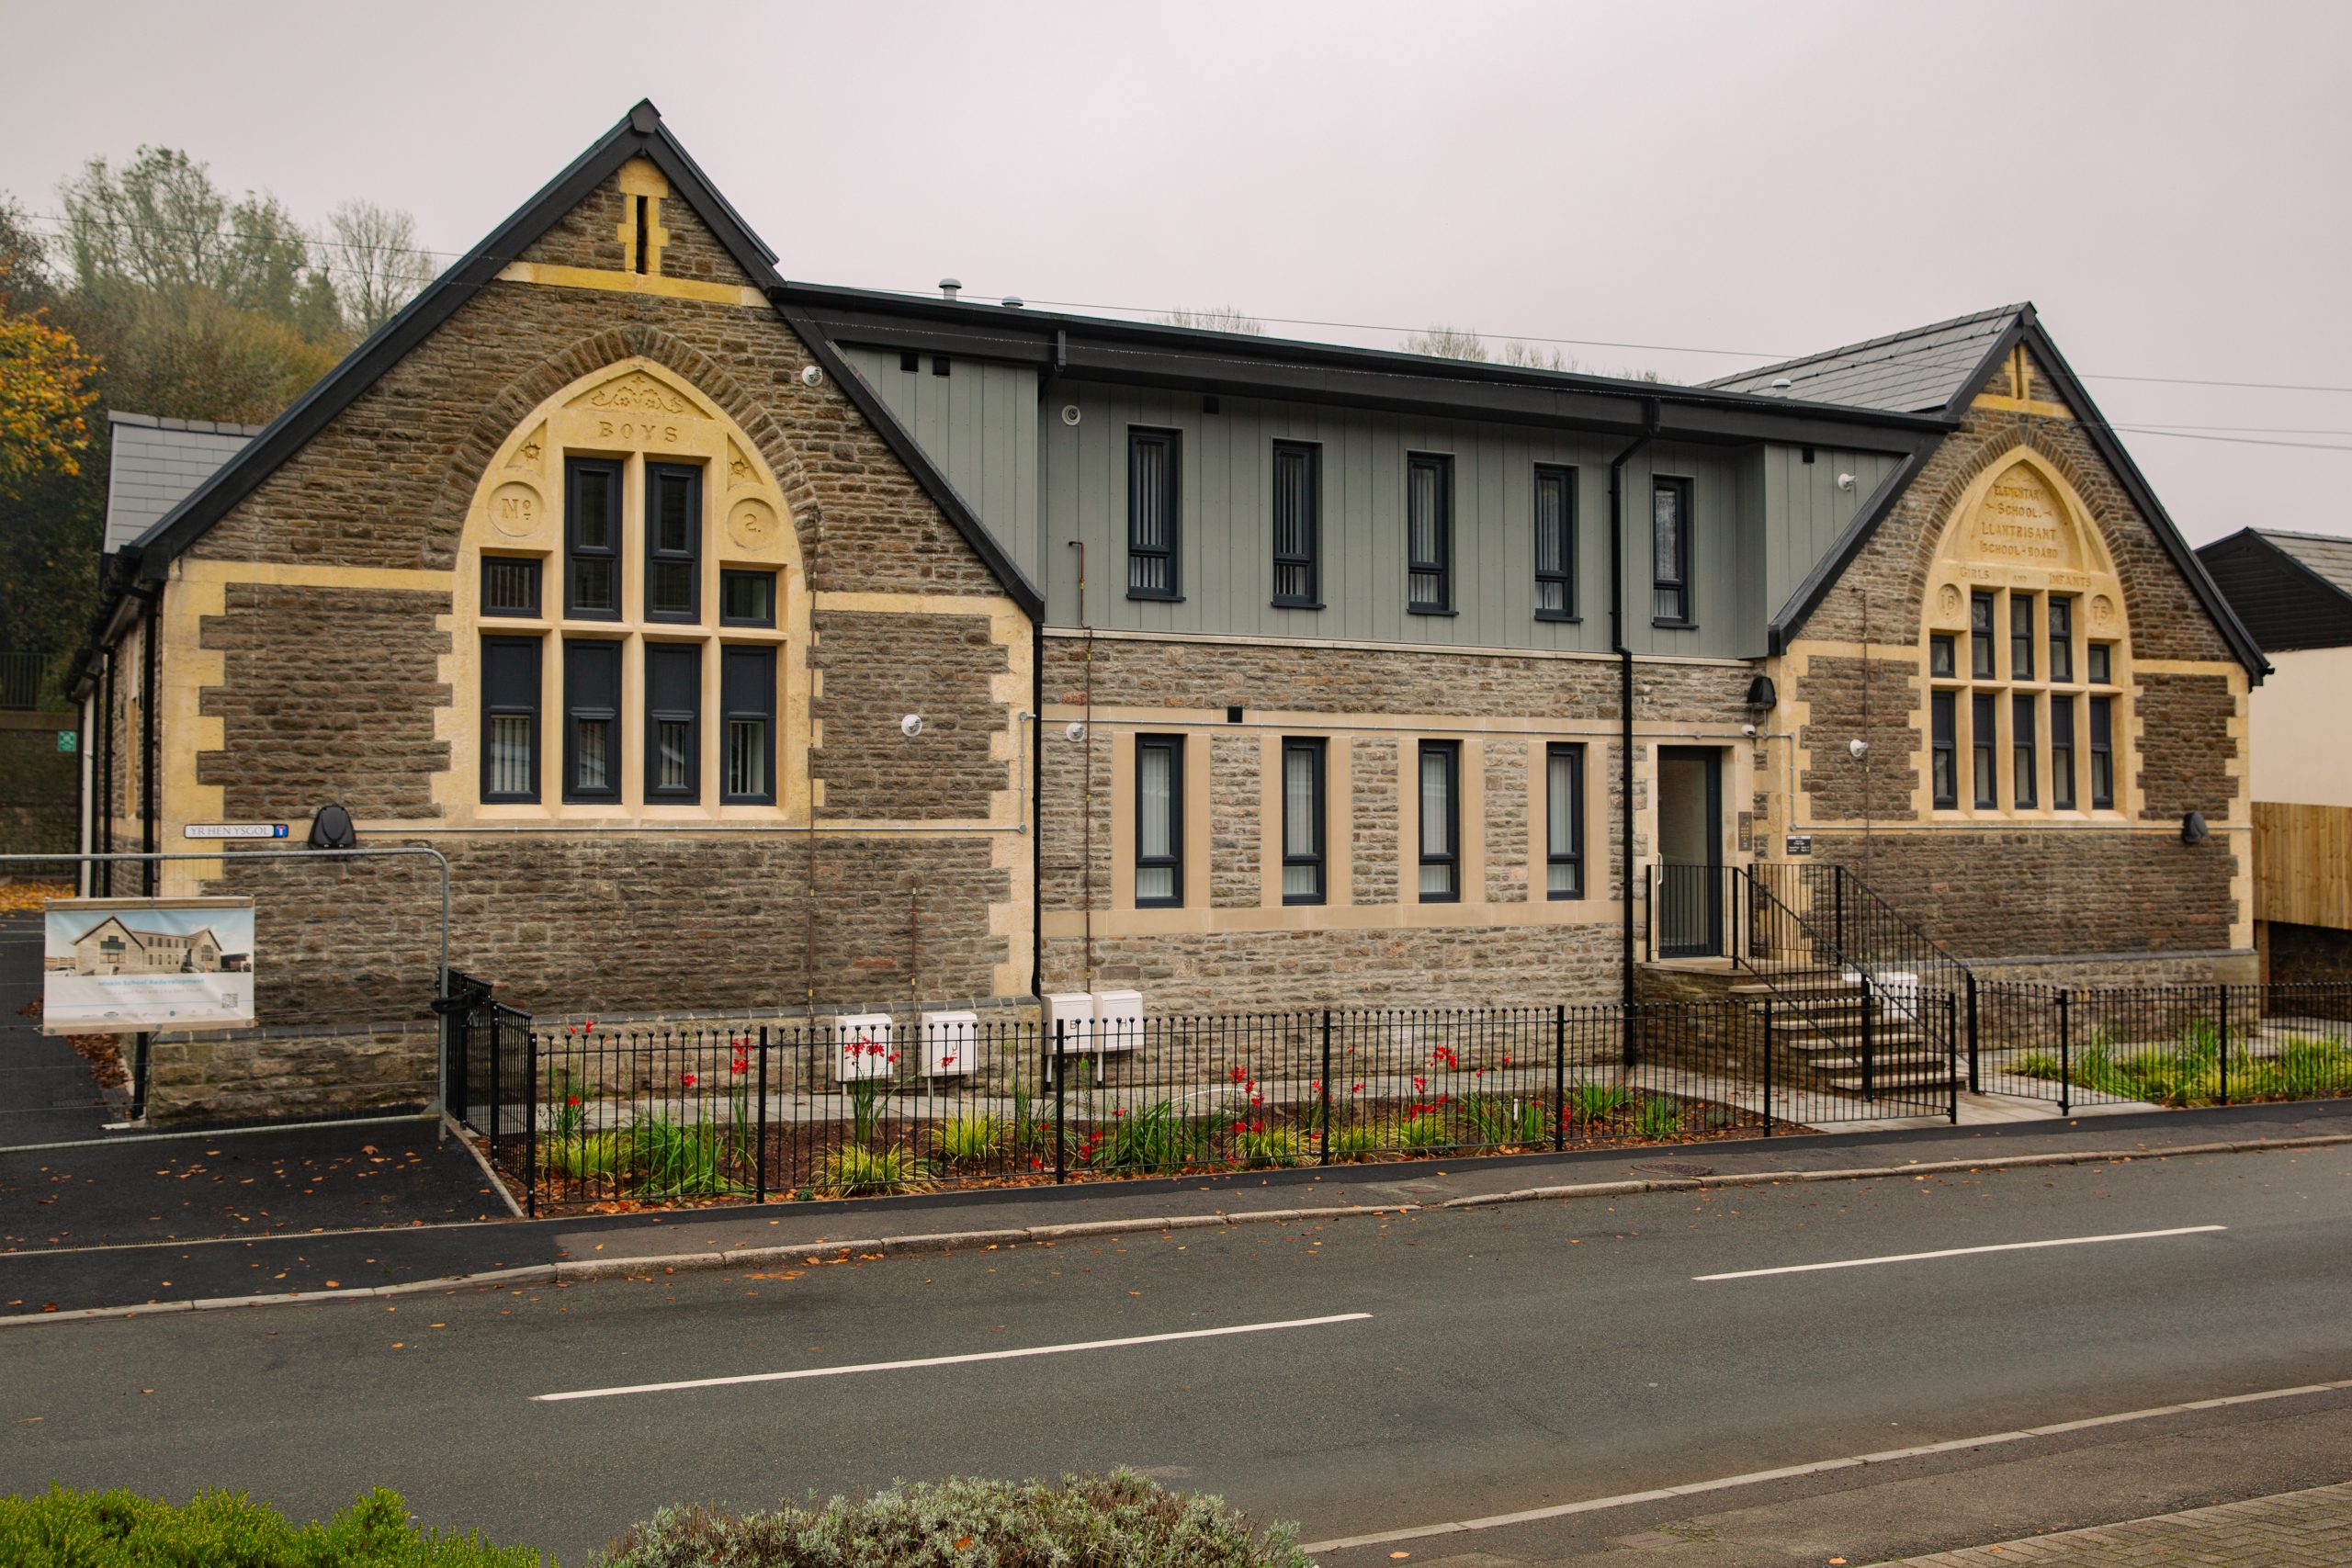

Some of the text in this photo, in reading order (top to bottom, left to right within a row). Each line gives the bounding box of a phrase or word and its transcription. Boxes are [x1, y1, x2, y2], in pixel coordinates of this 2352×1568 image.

[598, 420, 678, 443] BOYS
[1993, 484, 2044, 501] ELEMENTARY
[1982, 522, 2057, 540] LLANTRISANT
[1960, 566, 2093, 588] GIRLS AND INFANTS
[1939, 594, 1955, 610] 18
[190, 826, 269, 835] YR HEN YSGOL
[1069, 1020, 1078, 1030] B
